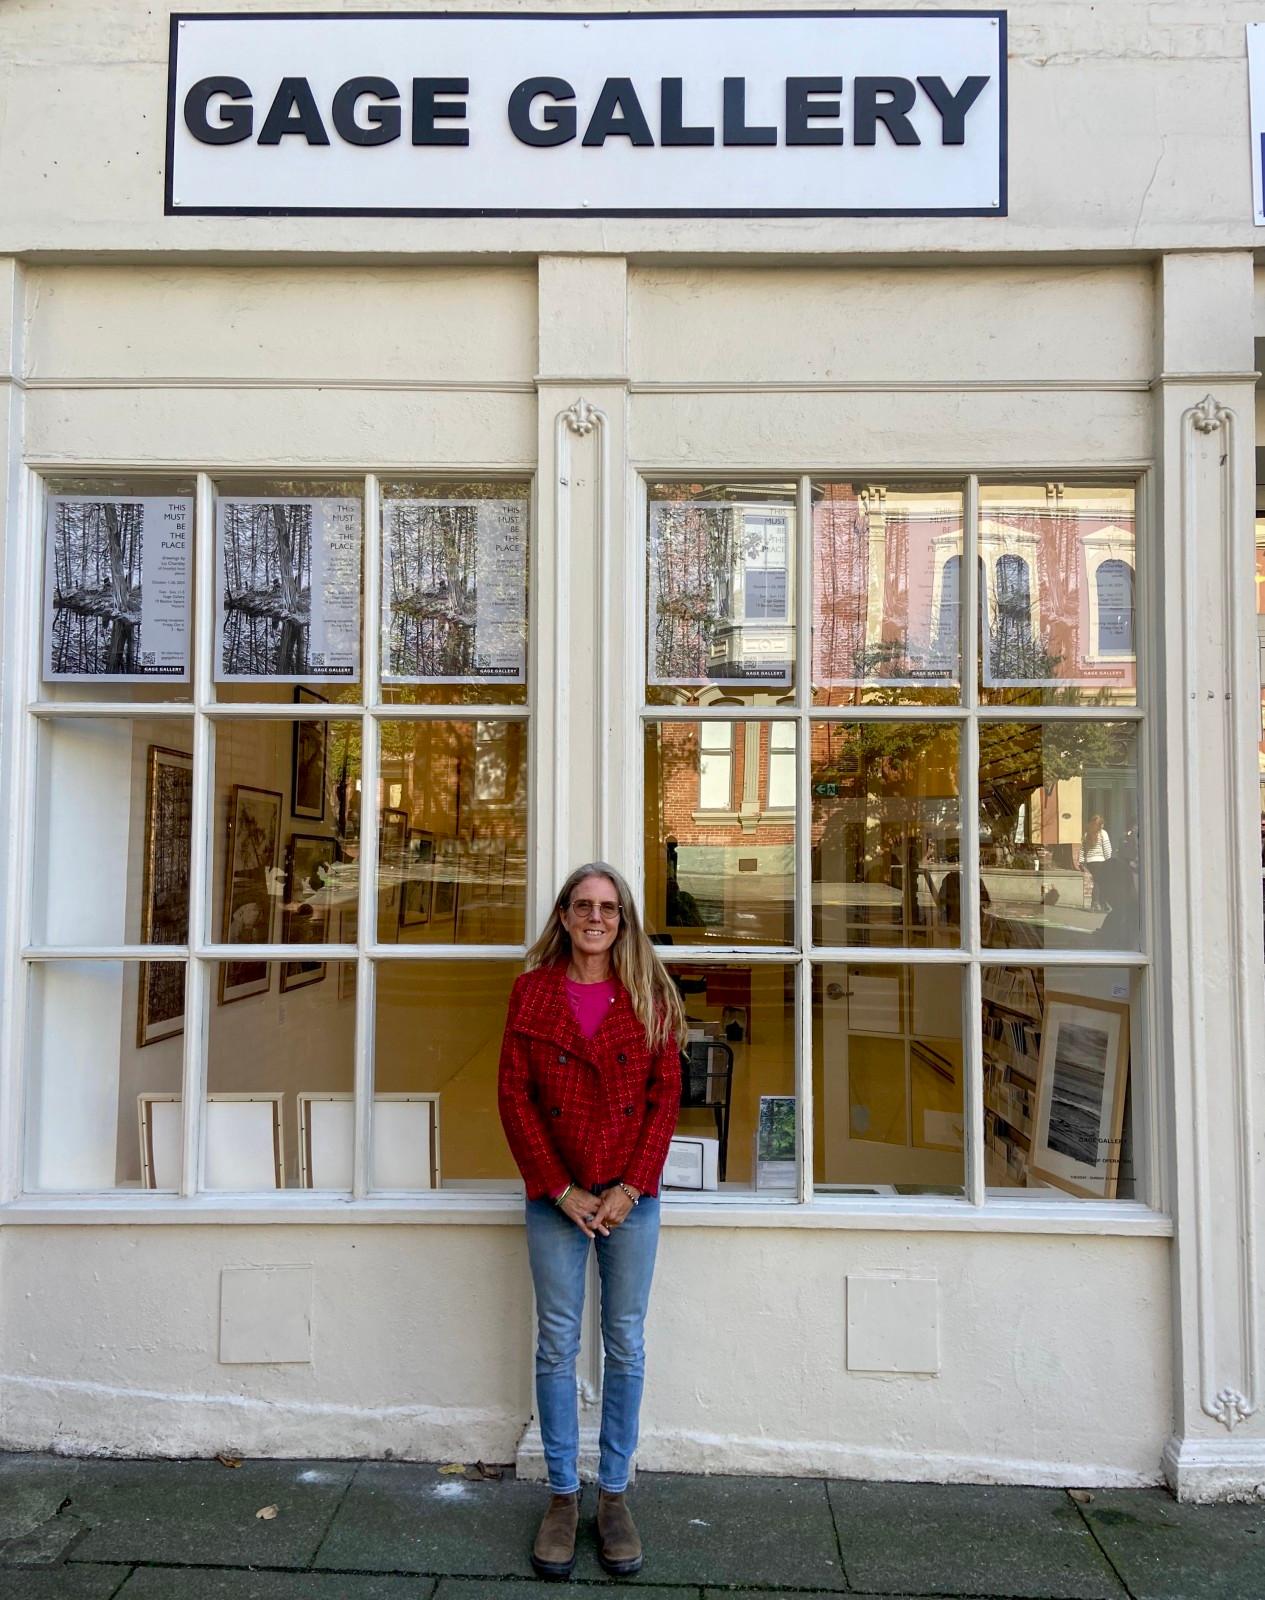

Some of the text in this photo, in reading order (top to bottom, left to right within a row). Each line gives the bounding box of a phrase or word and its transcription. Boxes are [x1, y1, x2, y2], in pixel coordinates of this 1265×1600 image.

[183, 75, 991, 147] GAGE GALLERY
[498, 516, 519, 524] MUST
[764, 517, 785, 525] MUST
[511, 525, 519, 533] BE
[161, 541, 185, 549] PLACE
[330, 542, 354, 550] PLACE
[495, 544, 519, 552] PLACE
